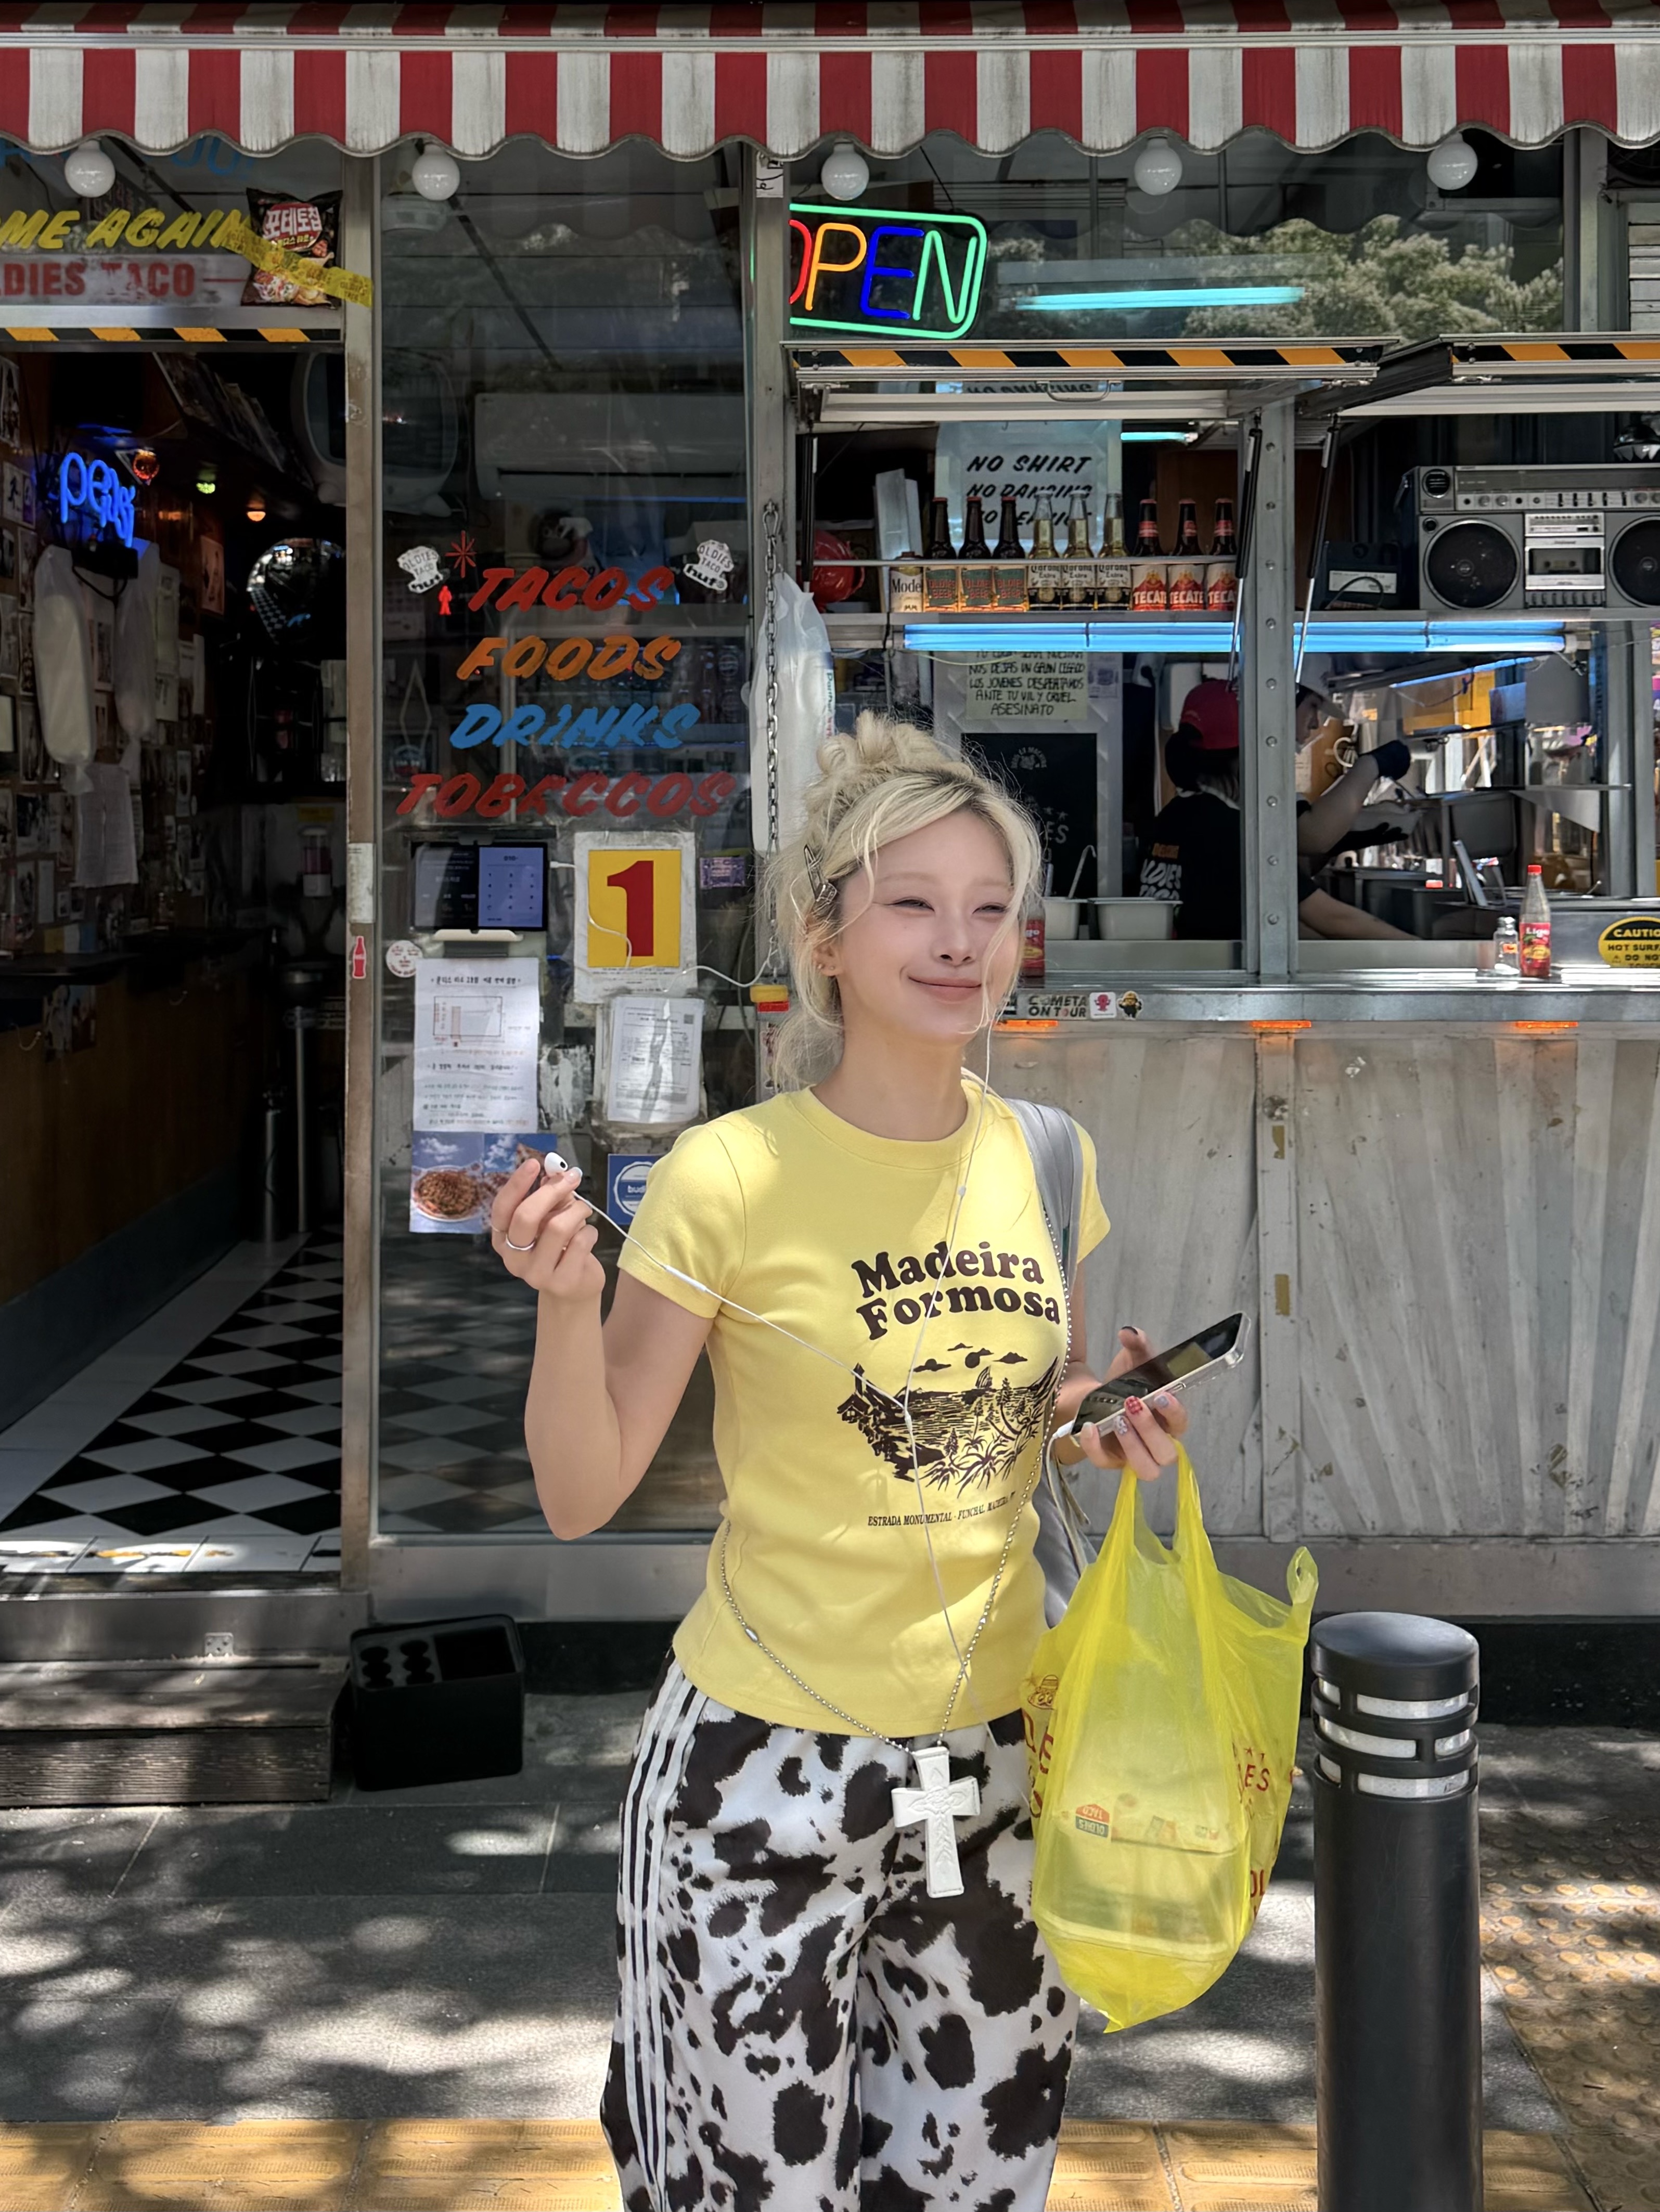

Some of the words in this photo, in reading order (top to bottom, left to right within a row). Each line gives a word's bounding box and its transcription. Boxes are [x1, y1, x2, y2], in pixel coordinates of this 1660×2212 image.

[0, 209, 80, 249] ME
[86, 208, 251, 249] AGAIN
[262, 206, 323, 239] 포테토칩
[0, 262, 86, 296] DIES
[100, 262, 195, 297] TACO
[967, 456, 1004, 472] NO
[1012, 455, 1092, 473] SHIRT
[966, 484, 997, 497] NO
[403, 551, 437, 570] OLDIES
[699, 545, 731, 568] OLDIES
[701, 558, 720, 573] TACO
[687, 565, 717, 586] hut
[469, 566, 674, 612] TACOS
[456, 635, 681, 680] FOODS
[969, 664, 986, 675] NOS
[991, 662, 1018, 674] DEJAS
[970, 677, 984, 689] LOS
[987, 677, 1023, 689] JOVENES
[976, 690, 1002, 701] ANTE
[1008, 691, 1019, 701] TU
[1021, 691, 1035, 701] VIL
[1037, 692, 1043, 702] Y
[990, 703, 1054, 716] ASESINATO
[449, 703, 701, 749] DRINKS
[608, 860, 654, 956] 1
[1028, 995, 1087, 1006] COMETA
[1028, 1006, 1050, 1017] ON
[1053, 1006, 1086, 1017] TOUR
[851, 1241, 1044, 1298] Madeira
[856, 1286, 1060, 1340] Formosa
[868, 1515, 902, 1527] ESTRADA
[903, 1511, 953, 1526] MONUMENTAL
[1083, 1806, 1103, 1820] TACO
[1079, 1819, 1105, 1835] OLDIES
